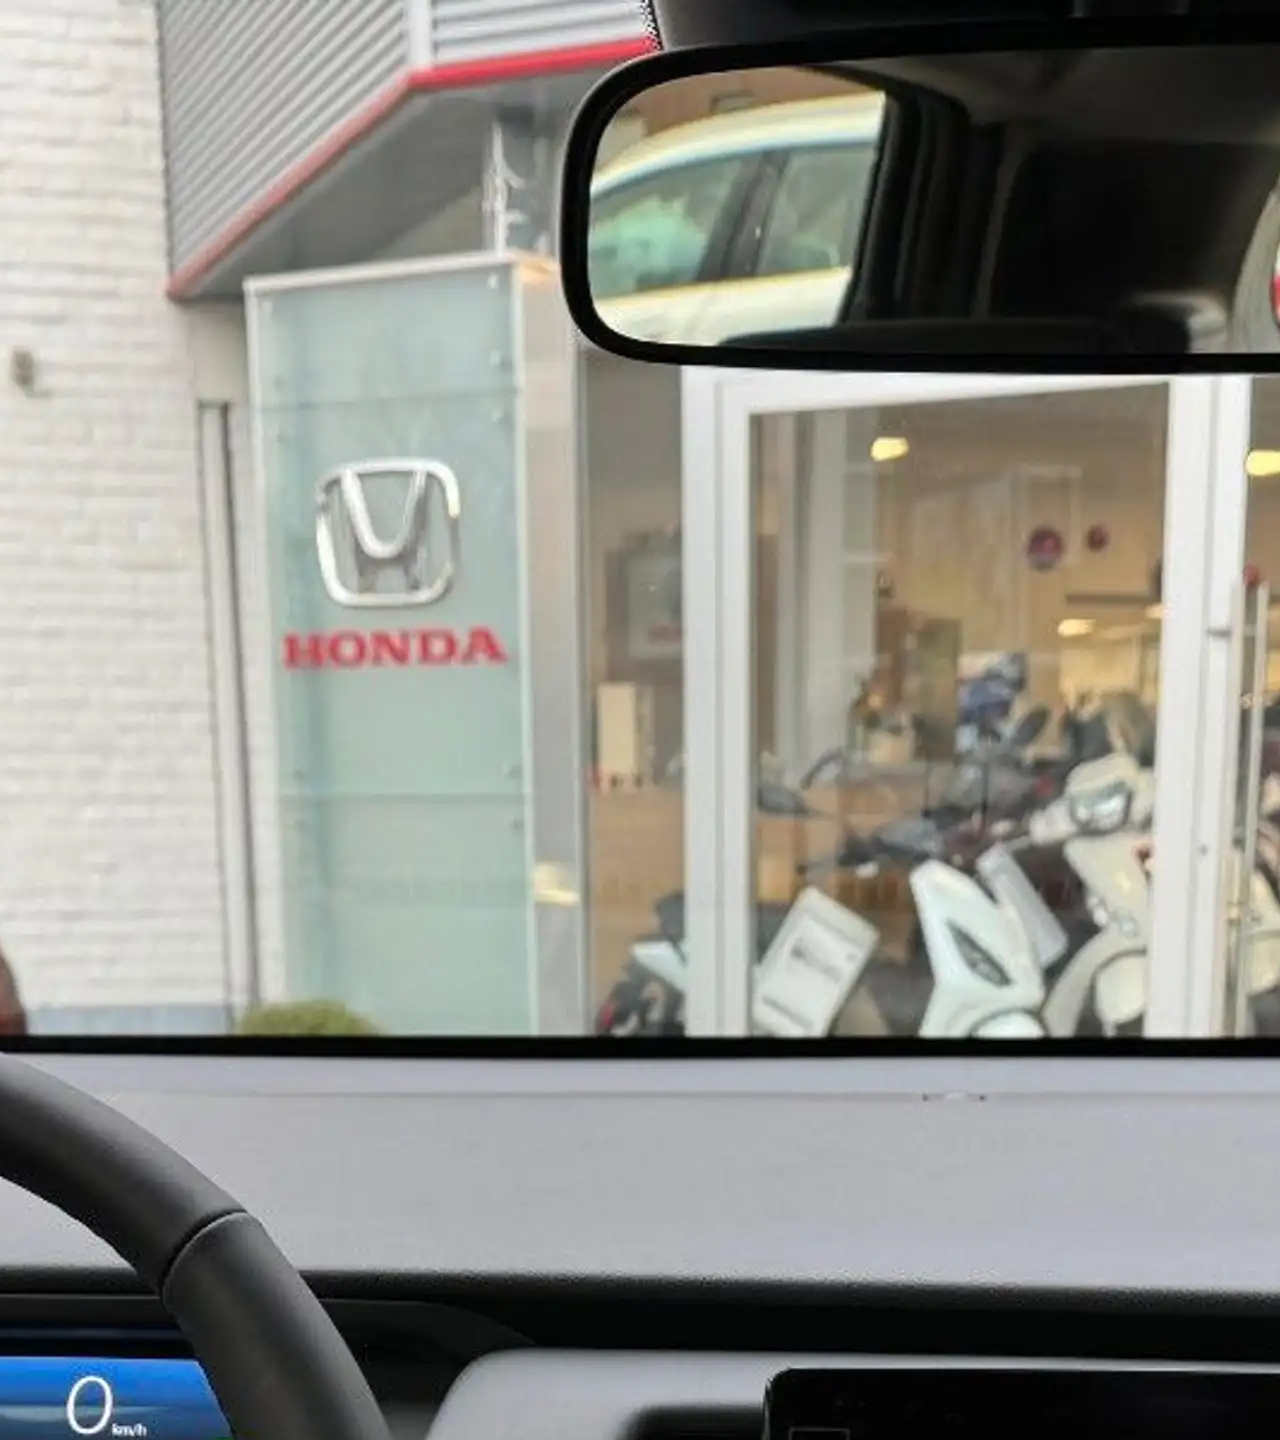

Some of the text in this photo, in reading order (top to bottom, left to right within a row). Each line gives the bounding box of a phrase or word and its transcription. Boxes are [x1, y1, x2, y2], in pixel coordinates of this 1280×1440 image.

[283, 625, 508, 671] HONDA
[67, 1375, 113, 1435] 0
[111, 1422, 147, 1437] km/h
